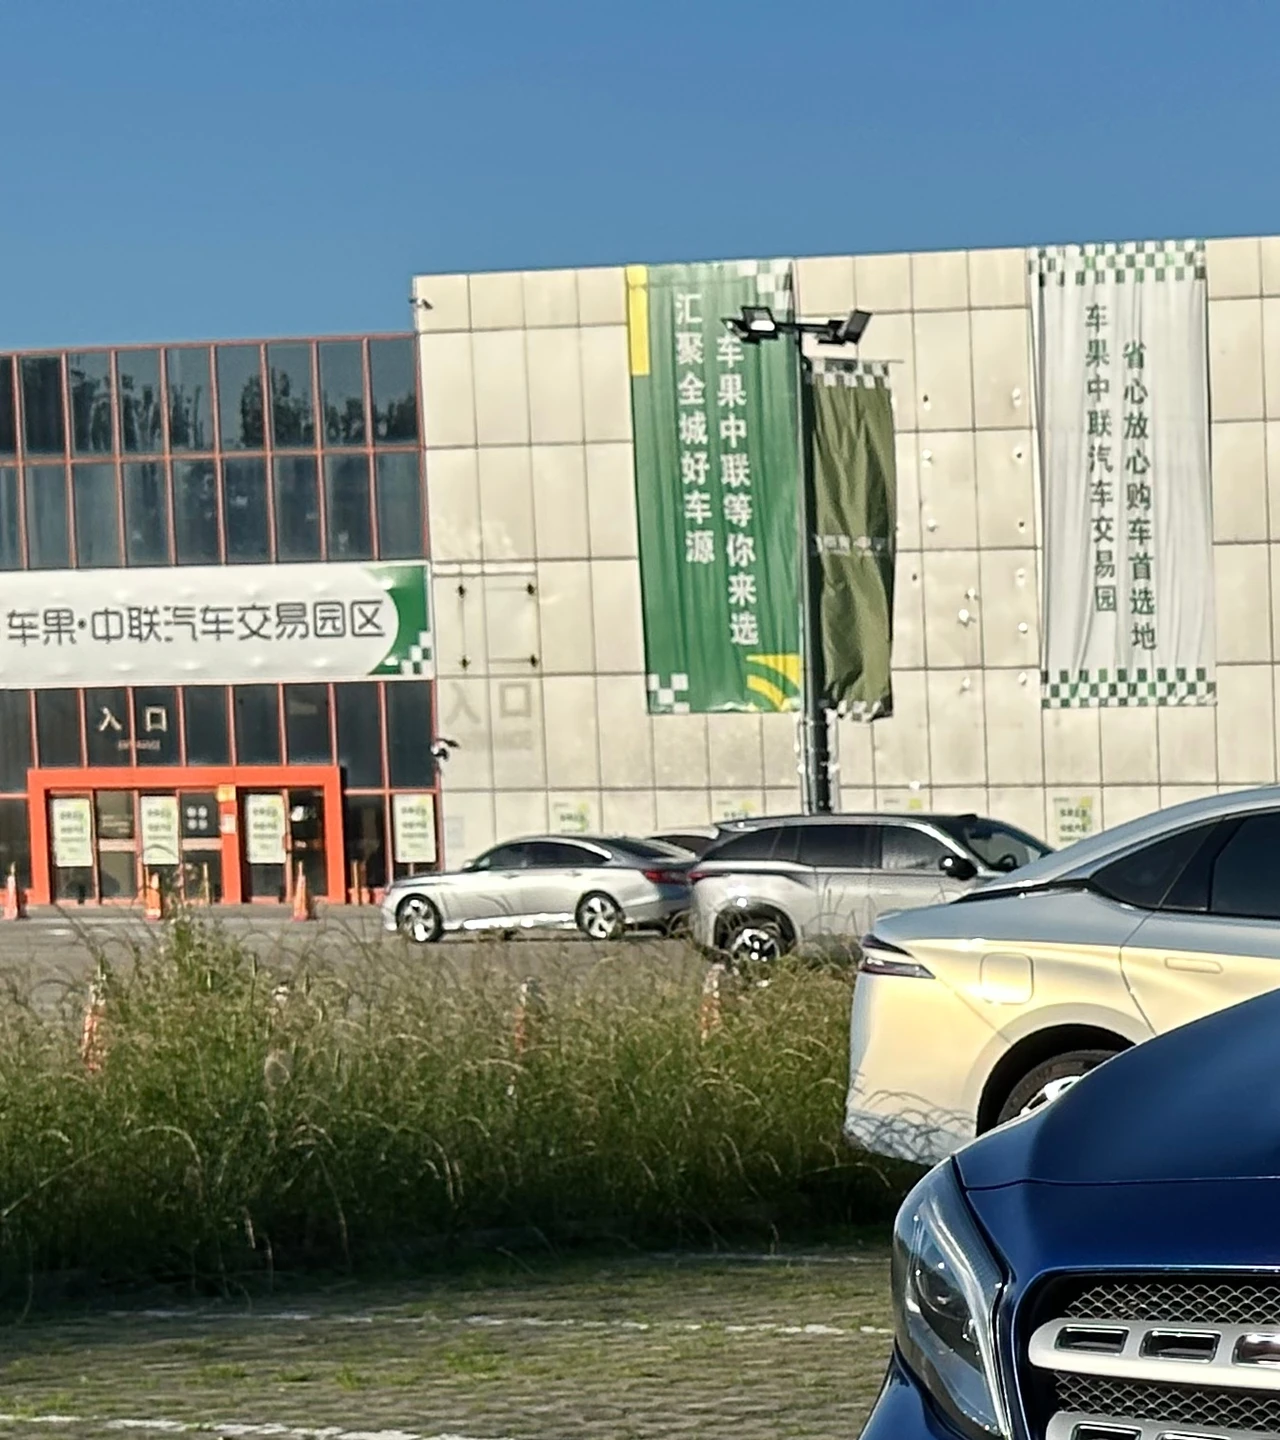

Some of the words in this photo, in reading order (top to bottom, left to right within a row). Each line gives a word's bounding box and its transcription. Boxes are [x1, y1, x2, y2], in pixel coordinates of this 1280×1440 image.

[675, 293, 715, 564] 汇聚全城好车源
[716, 333, 759, 645] 车果中联等你来选
[1085, 304, 1117, 612] 车果中联汽车交易园
[1122, 339, 1157, 651] 省心放心购车首选地
[7, 600, 385, 646] 车果·中联汽车交易园区
[100, 707, 167, 732] 入口
